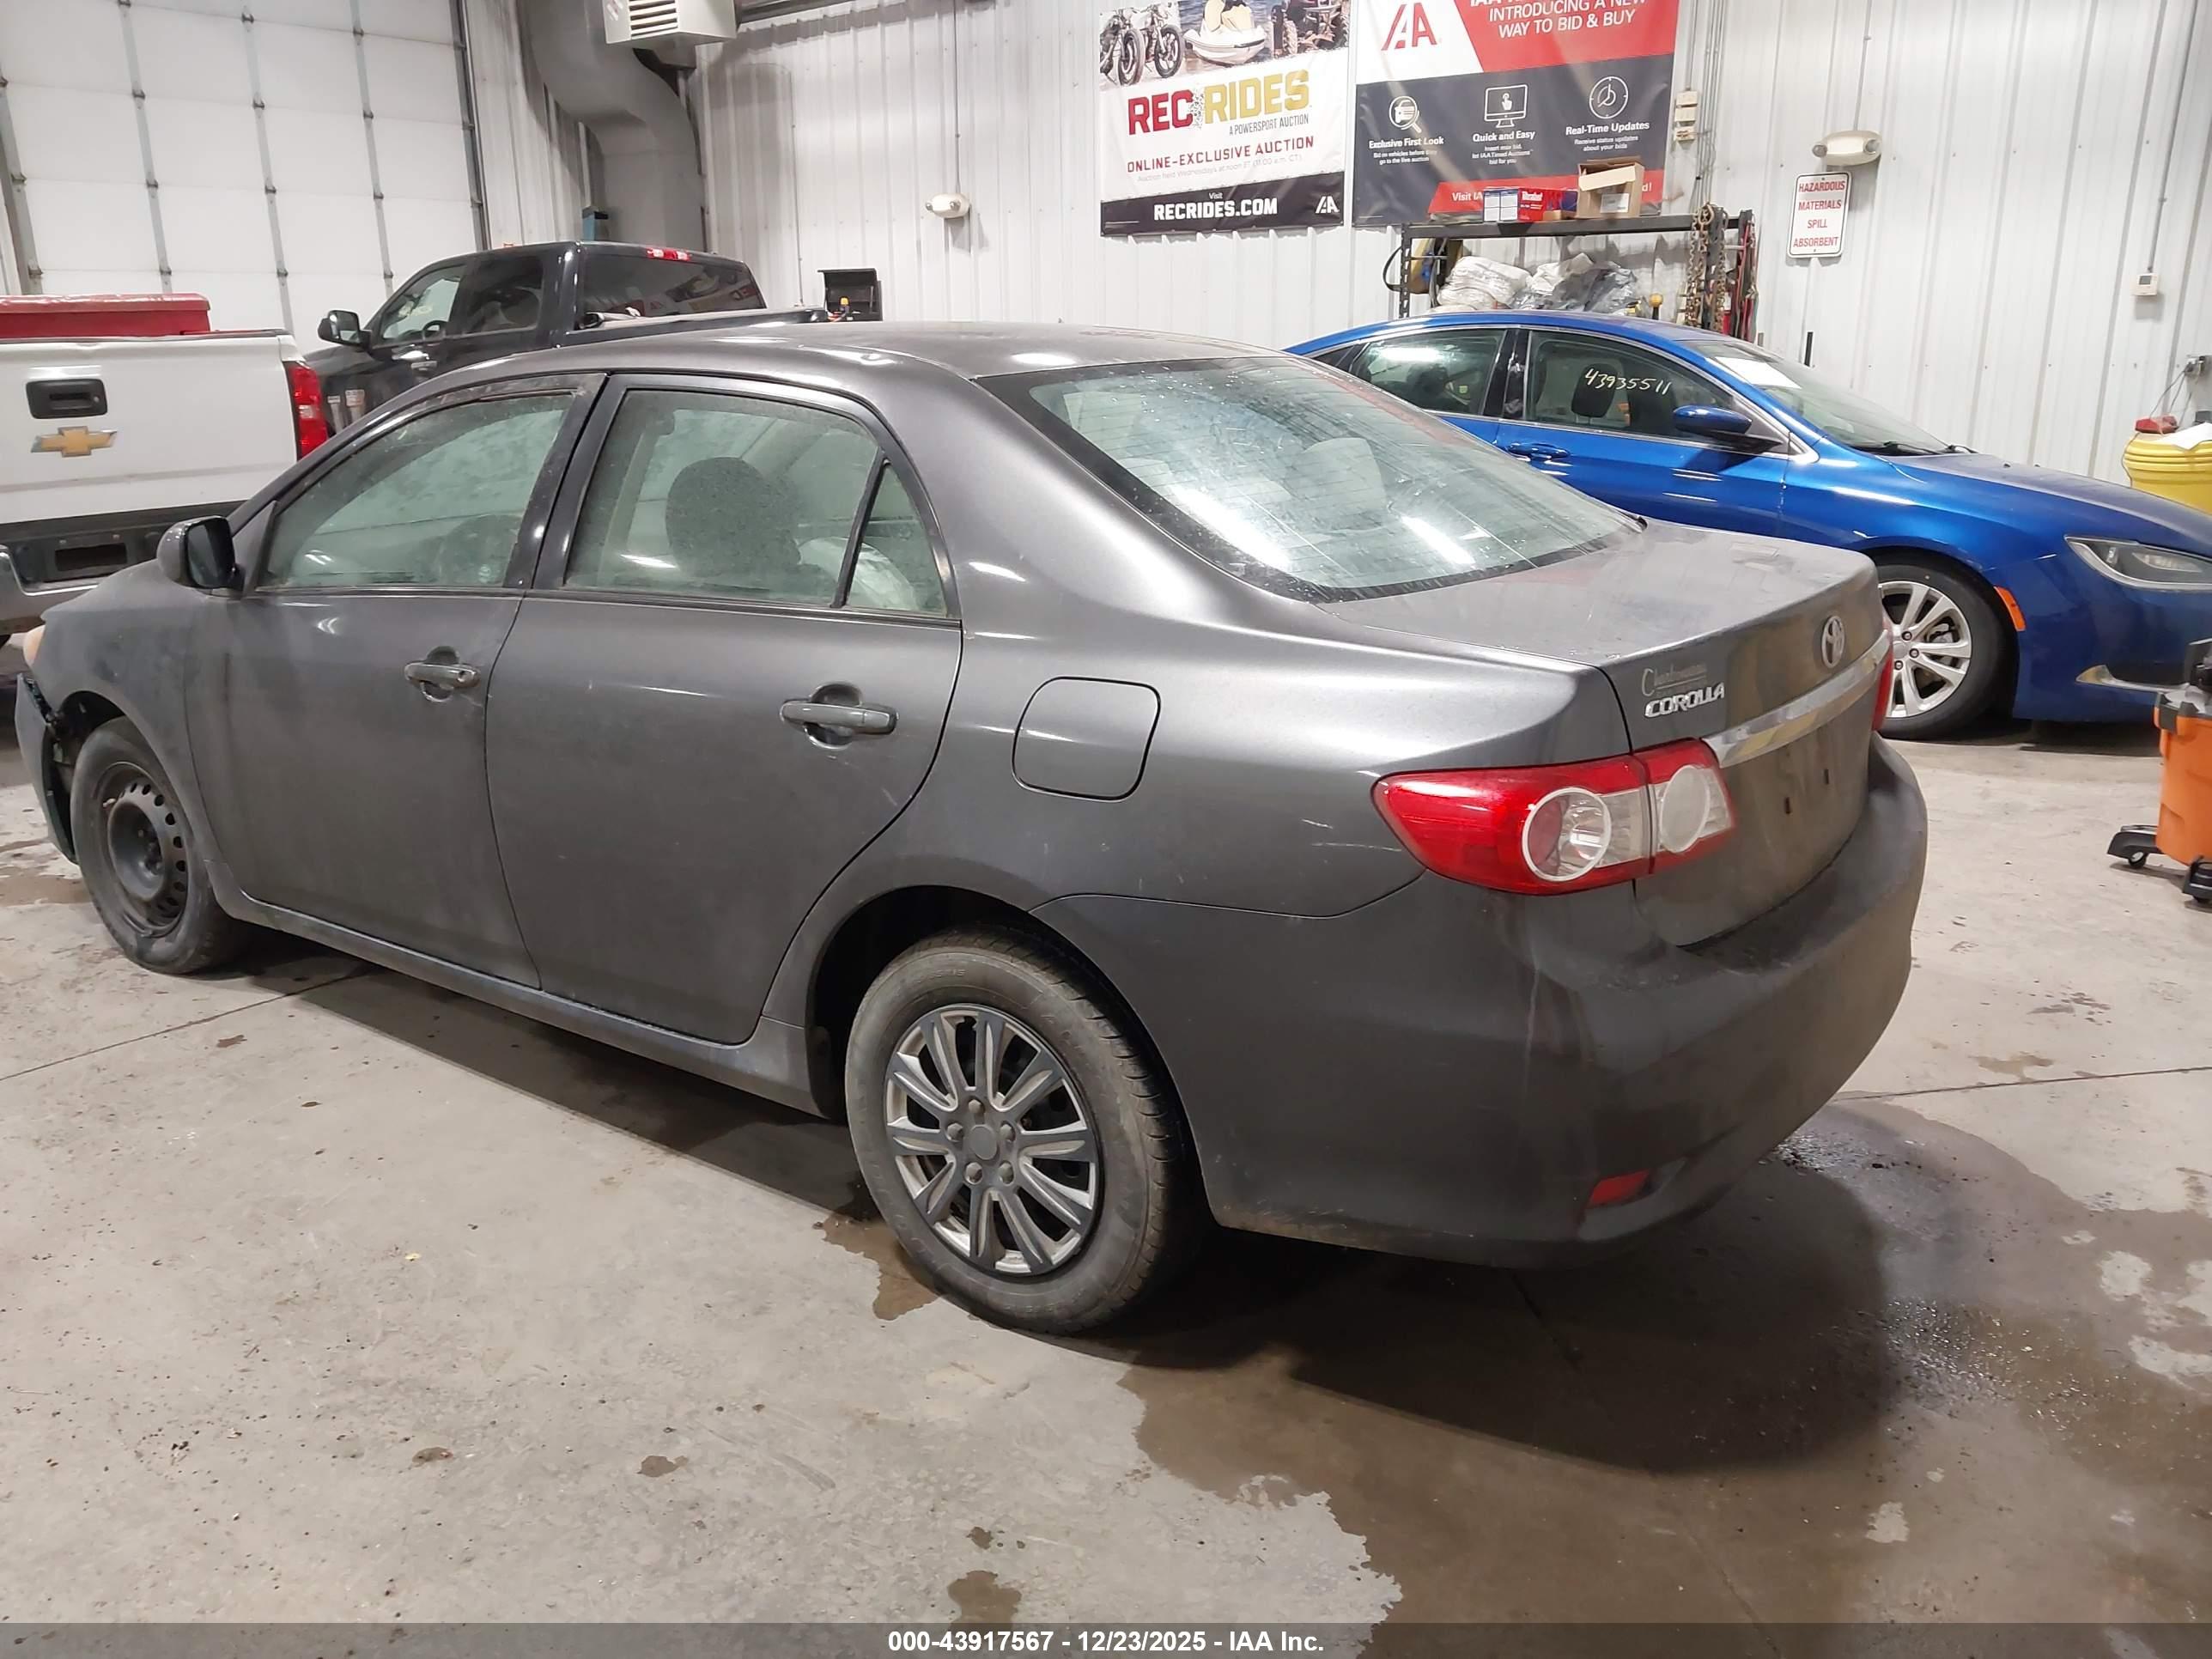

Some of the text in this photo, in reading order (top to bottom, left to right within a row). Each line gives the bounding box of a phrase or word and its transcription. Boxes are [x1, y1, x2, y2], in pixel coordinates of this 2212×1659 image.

[1489, 0, 1590, 21] INTRODUCING
[1594, 0, 1606, 9] A
[1498, 9, 1635, 38] WAY TO BID & BUY
[1127, 69, 1310, 136] REC RIDES
[1229, 113, 1309, 136] A POWERSPORT AUCTION
[1565, 122, 1650, 136] Real-Time Updates
[1369, 136, 1444, 149] Exclusive First Look
[1473, 131, 1535, 142] Quick and Easy
[1127, 136, 1314, 173] ONLINE-EXCLUSIVE AUCTION
[1642, 182, 1652, 191] d!
[1799, 181, 1845, 192] HAZARDOUS
[1452, 191, 1483, 202] Visit IA
[1154, 198, 1278, 221] RECRIDES.COM
[1798, 199, 1842, 210] MATERIALS
[1808, 219, 1827, 228] SPILL
[1793, 237, 1838, 247] ABSORBENT
[1585, 368, 1672, 395] 43935511
[1644, 682, 1724, 718] COROLLA
